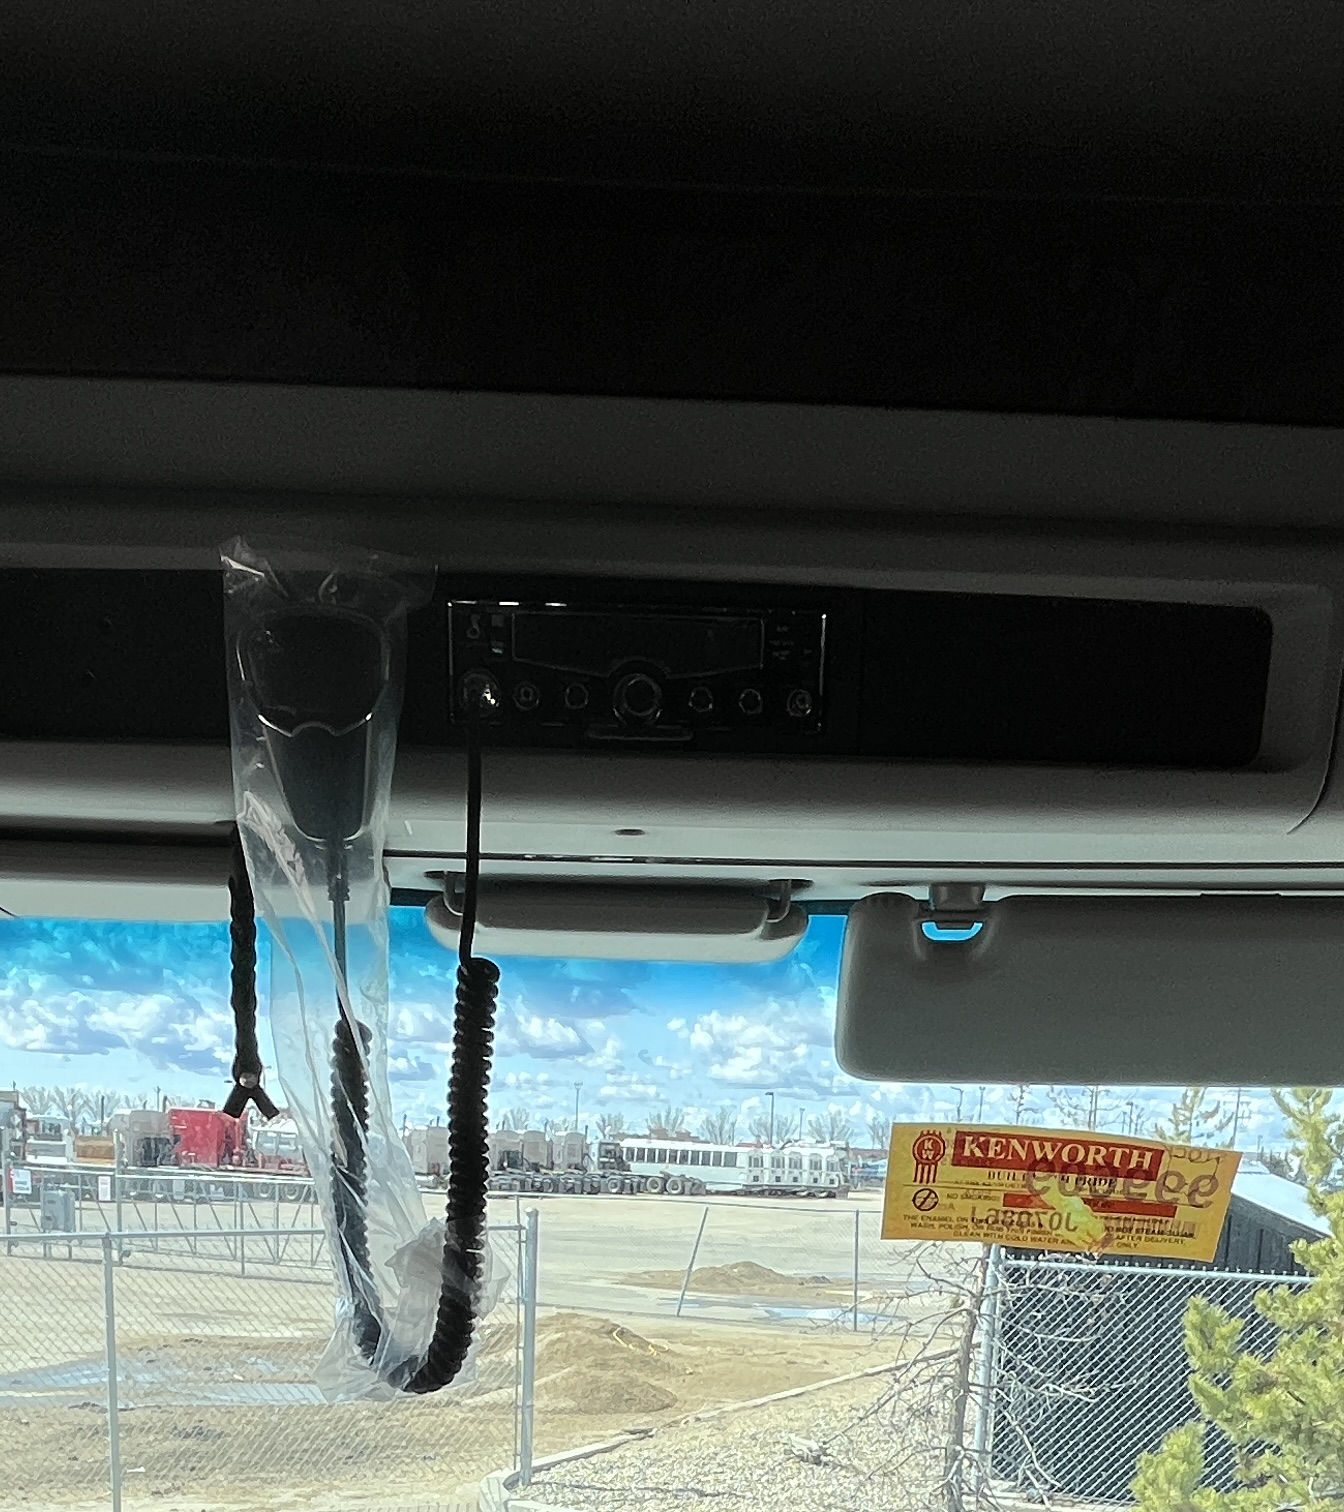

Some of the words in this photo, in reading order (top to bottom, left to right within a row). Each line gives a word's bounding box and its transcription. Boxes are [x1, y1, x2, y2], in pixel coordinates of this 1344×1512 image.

[963, 1135, 1153, 1170] KENWORTH
[1005, 1233, 1028, 1242] COLD
[1030, 1236, 1059, 1244] WATER
[1115, 1235, 1142, 1243] AFTER
